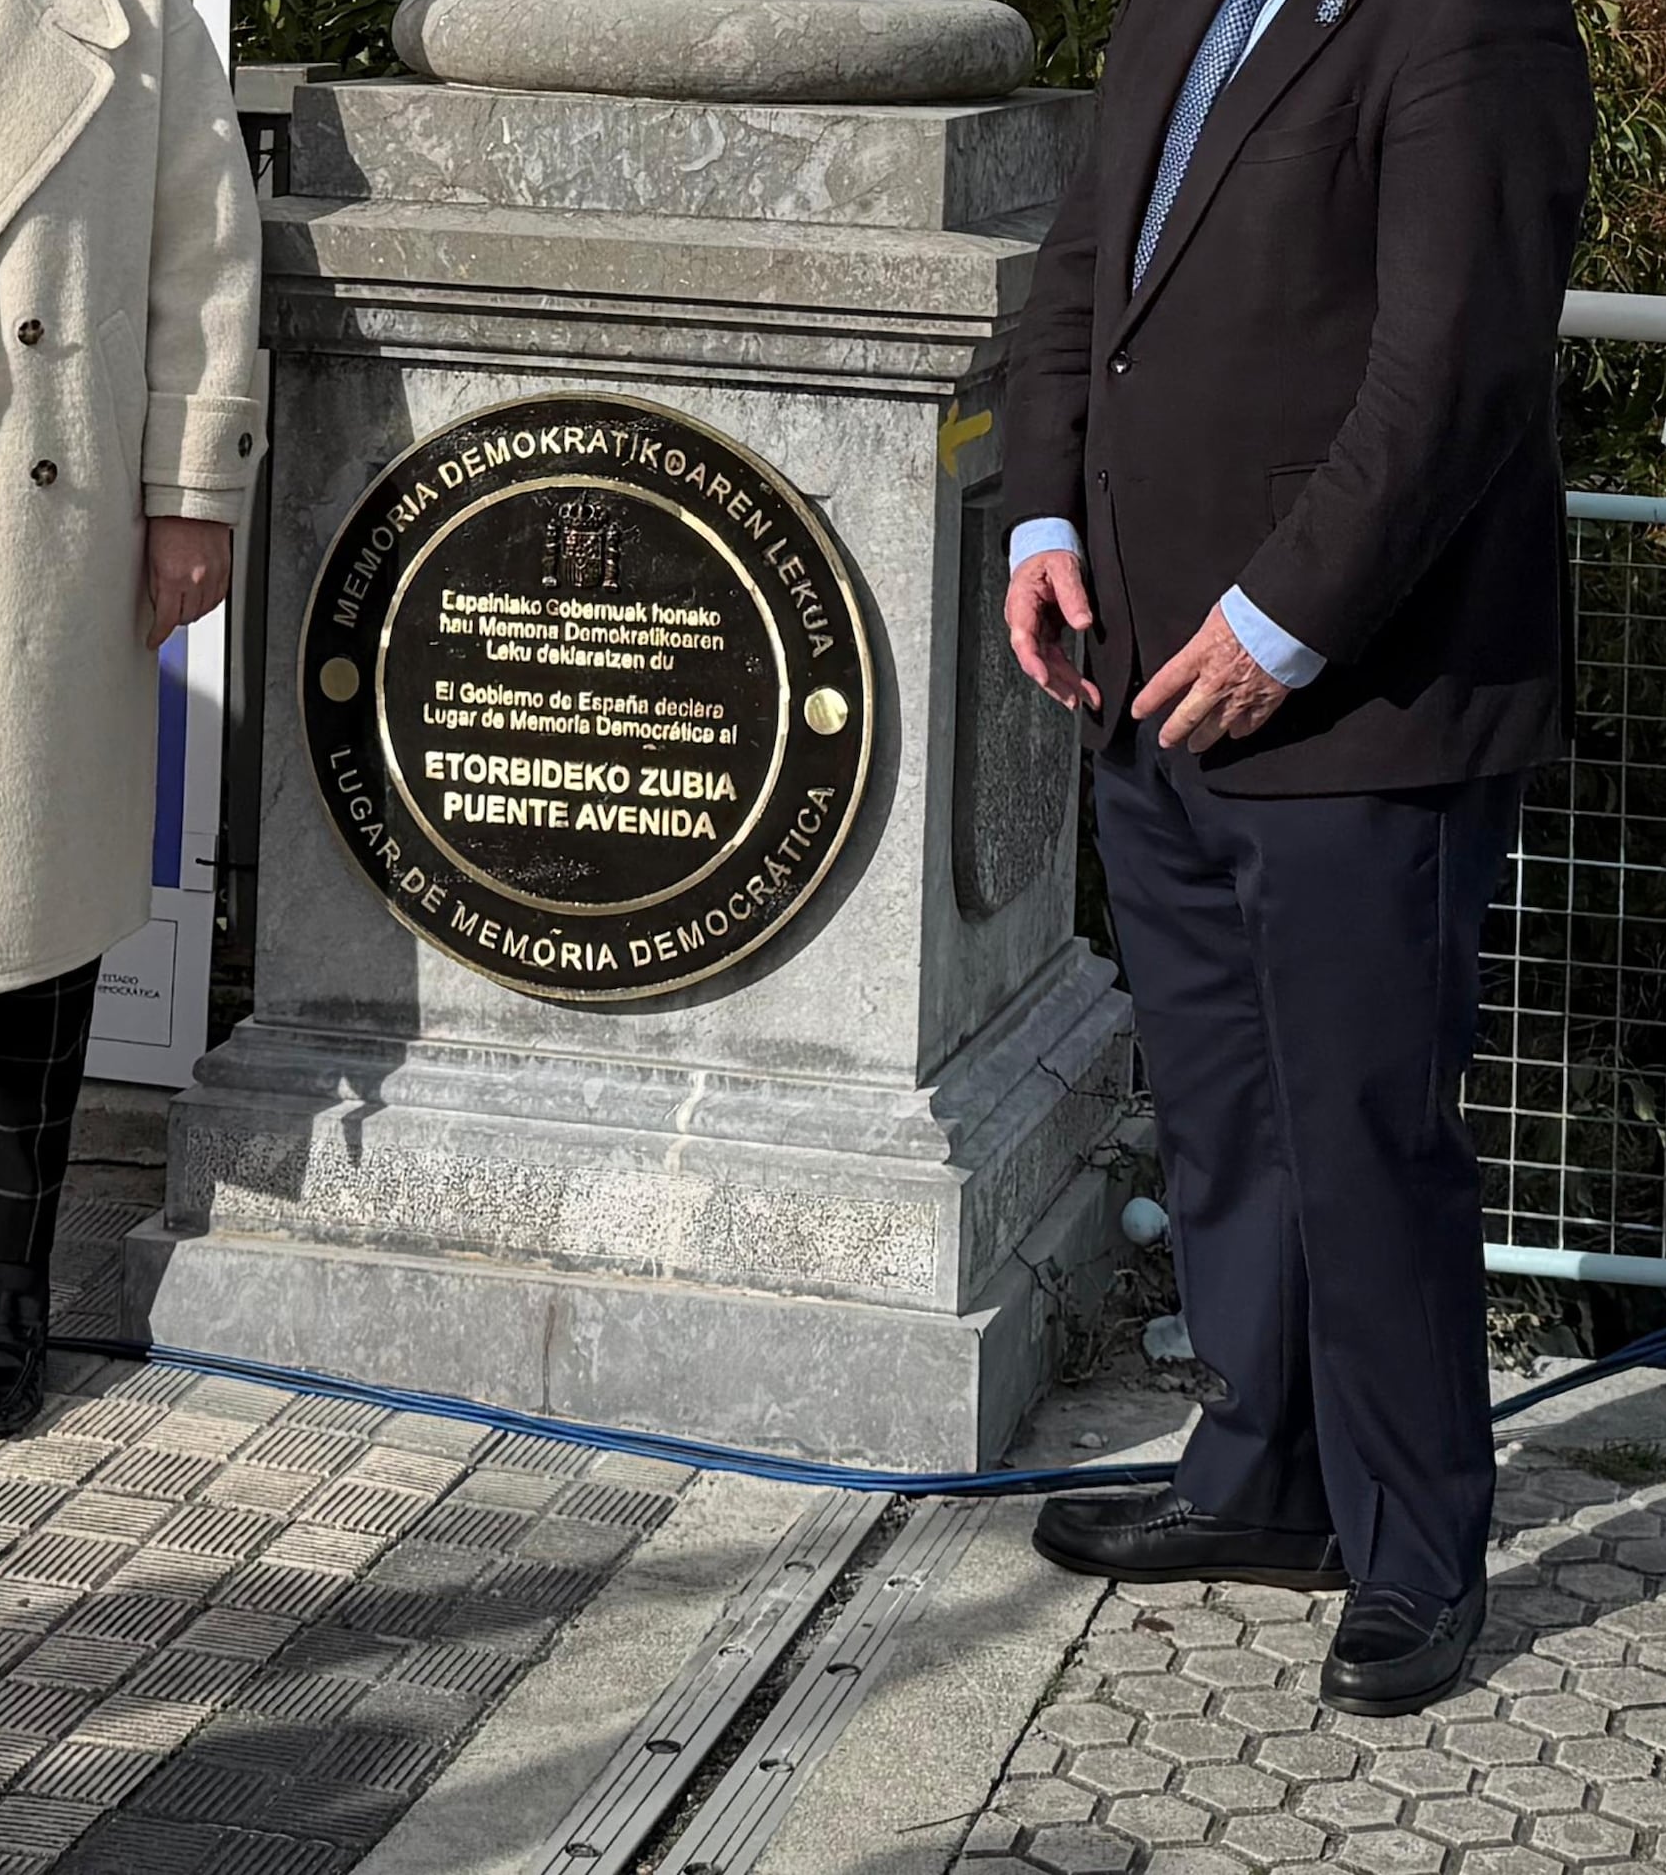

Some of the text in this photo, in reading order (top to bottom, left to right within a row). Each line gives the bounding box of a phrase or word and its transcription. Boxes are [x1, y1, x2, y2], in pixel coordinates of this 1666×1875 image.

[333, 426, 834, 658] MEMORIA DEMOKRATIKOAREN LEKUA
[442, 589, 721, 627] Espainiako Gobernuak honako
[439, 613, 473, 634] hau
[564, 622, 724, 651] Demokratikoaren
[487, 639, 674, 671] Leku deklaratzen du
[435, 681, 724, 720] El Gobierno de España declara
[423, 703, 737, 745] Lugar de Memoria Democrática al
[425, 750, 737, 802] ETORBIDEKO ZUBIA
[330, 749, 401, 869] LUGAR
[400, 867, 446, 913] DE
[443, 792, 717, 840] PUENTE AVENIDA
